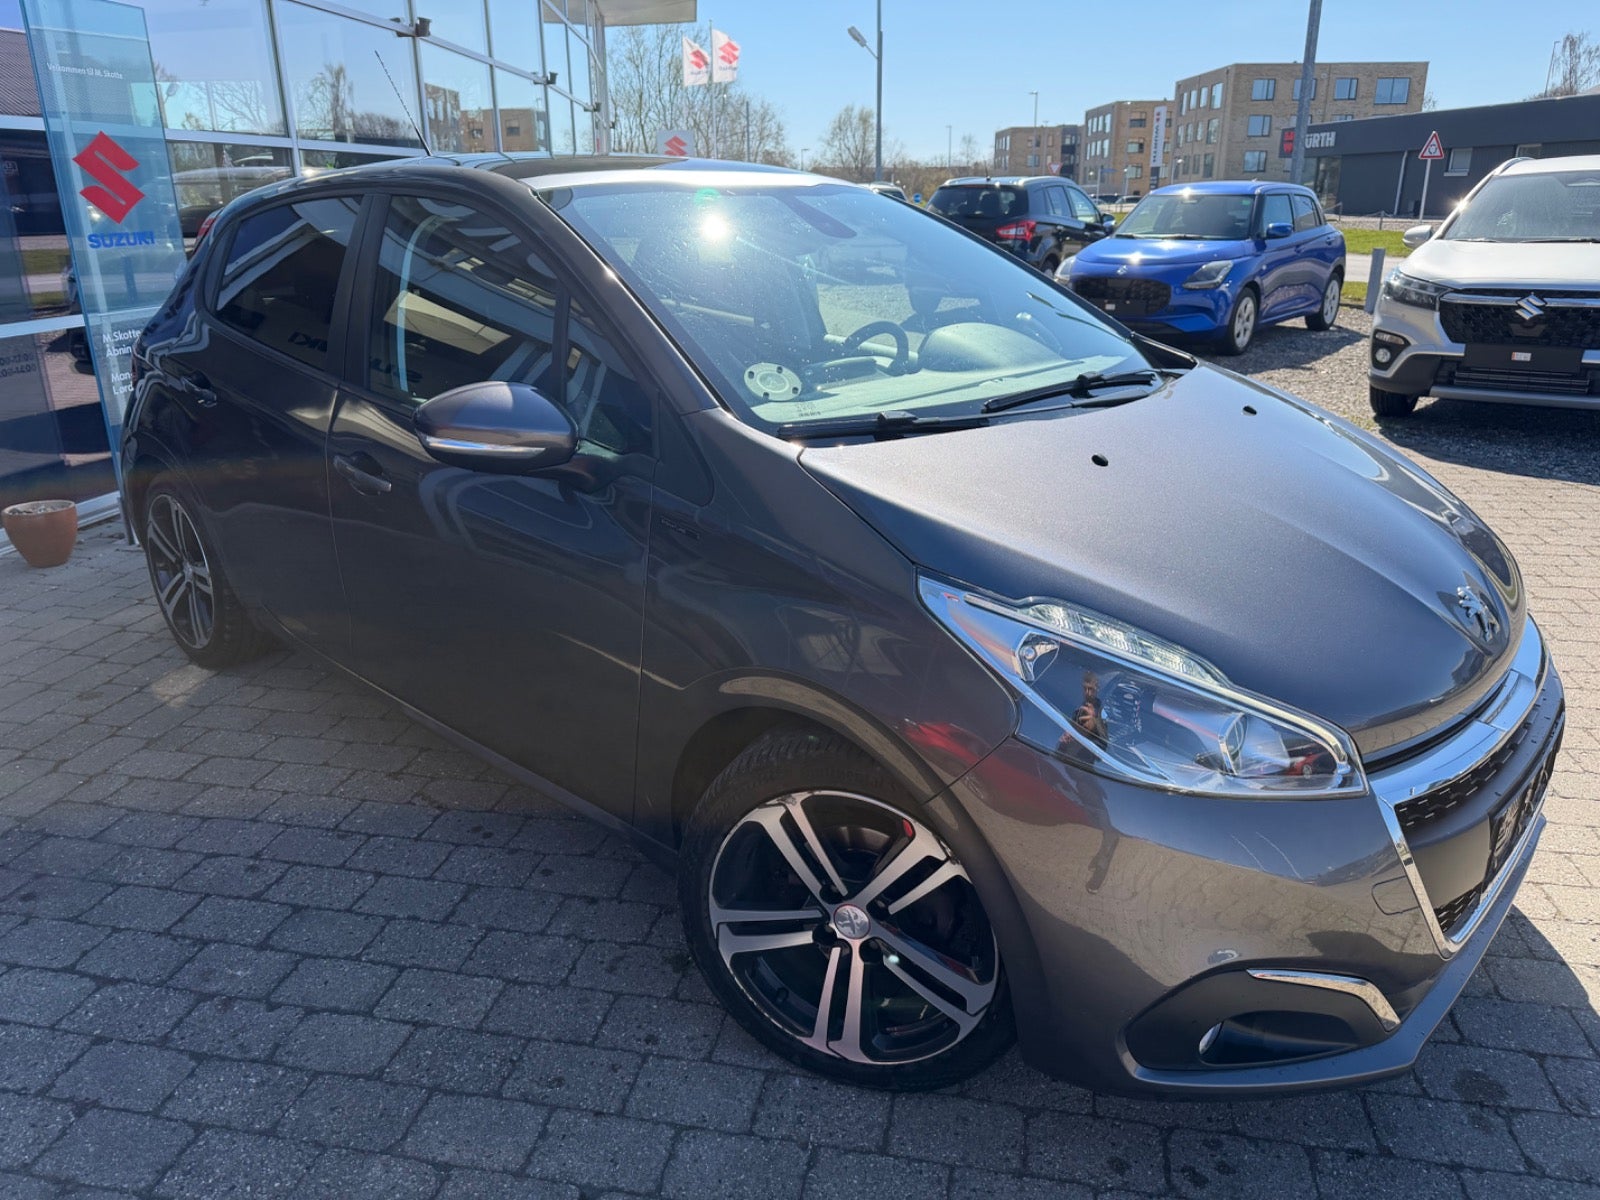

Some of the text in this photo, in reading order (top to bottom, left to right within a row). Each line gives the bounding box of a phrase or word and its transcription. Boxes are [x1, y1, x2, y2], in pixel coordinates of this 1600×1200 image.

[1305, 131, 1337, 149] ÜRTH
[87, 231, 155, 249] SUZUKI
[106, 344, 132, 358] Åbnin
[112, 380, 134, 395] Lørd
